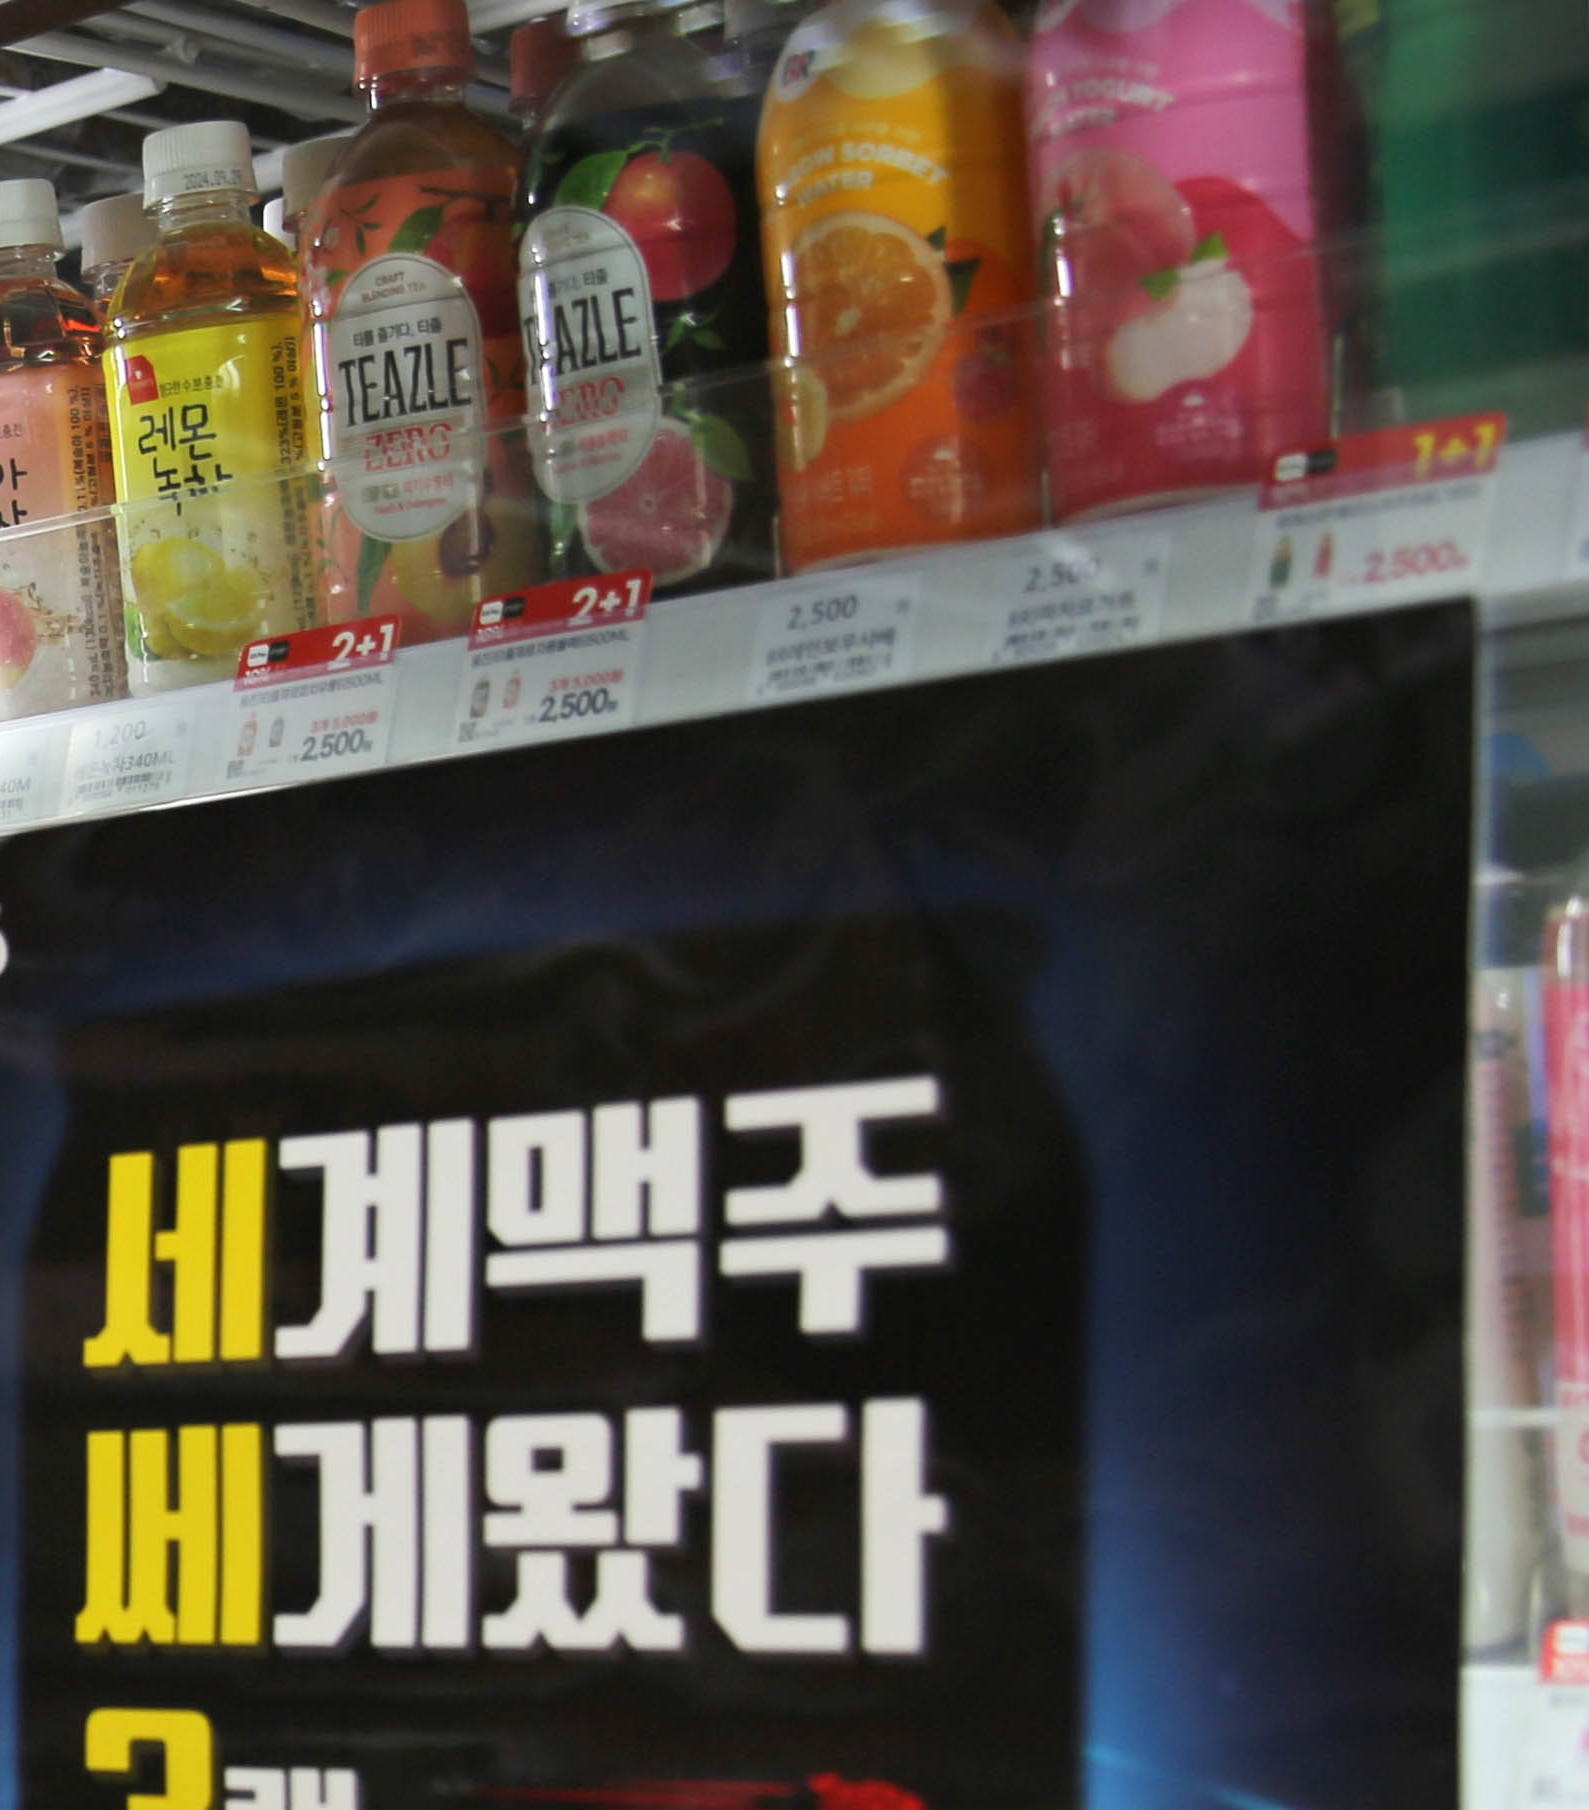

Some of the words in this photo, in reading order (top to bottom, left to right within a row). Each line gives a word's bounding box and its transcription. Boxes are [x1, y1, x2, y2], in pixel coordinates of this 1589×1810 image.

[525, 288, 641, 384] TAZLE
[339, 338, 472, 428] TEAZLE
[138, 404, 217, 460] 레몬
[364, 423, 452, 472] ZERO
[1414, 424, 1495, 480] 1+1
[569, 579, 641, 624] 2+1
[787, 594, 857, 630] 2,500
[330, 623, 395, 669] 2+1
[81, 1077, 948, 1368] 세계맥주
[74, 1397, 948, 1655] 쎄게왔다
